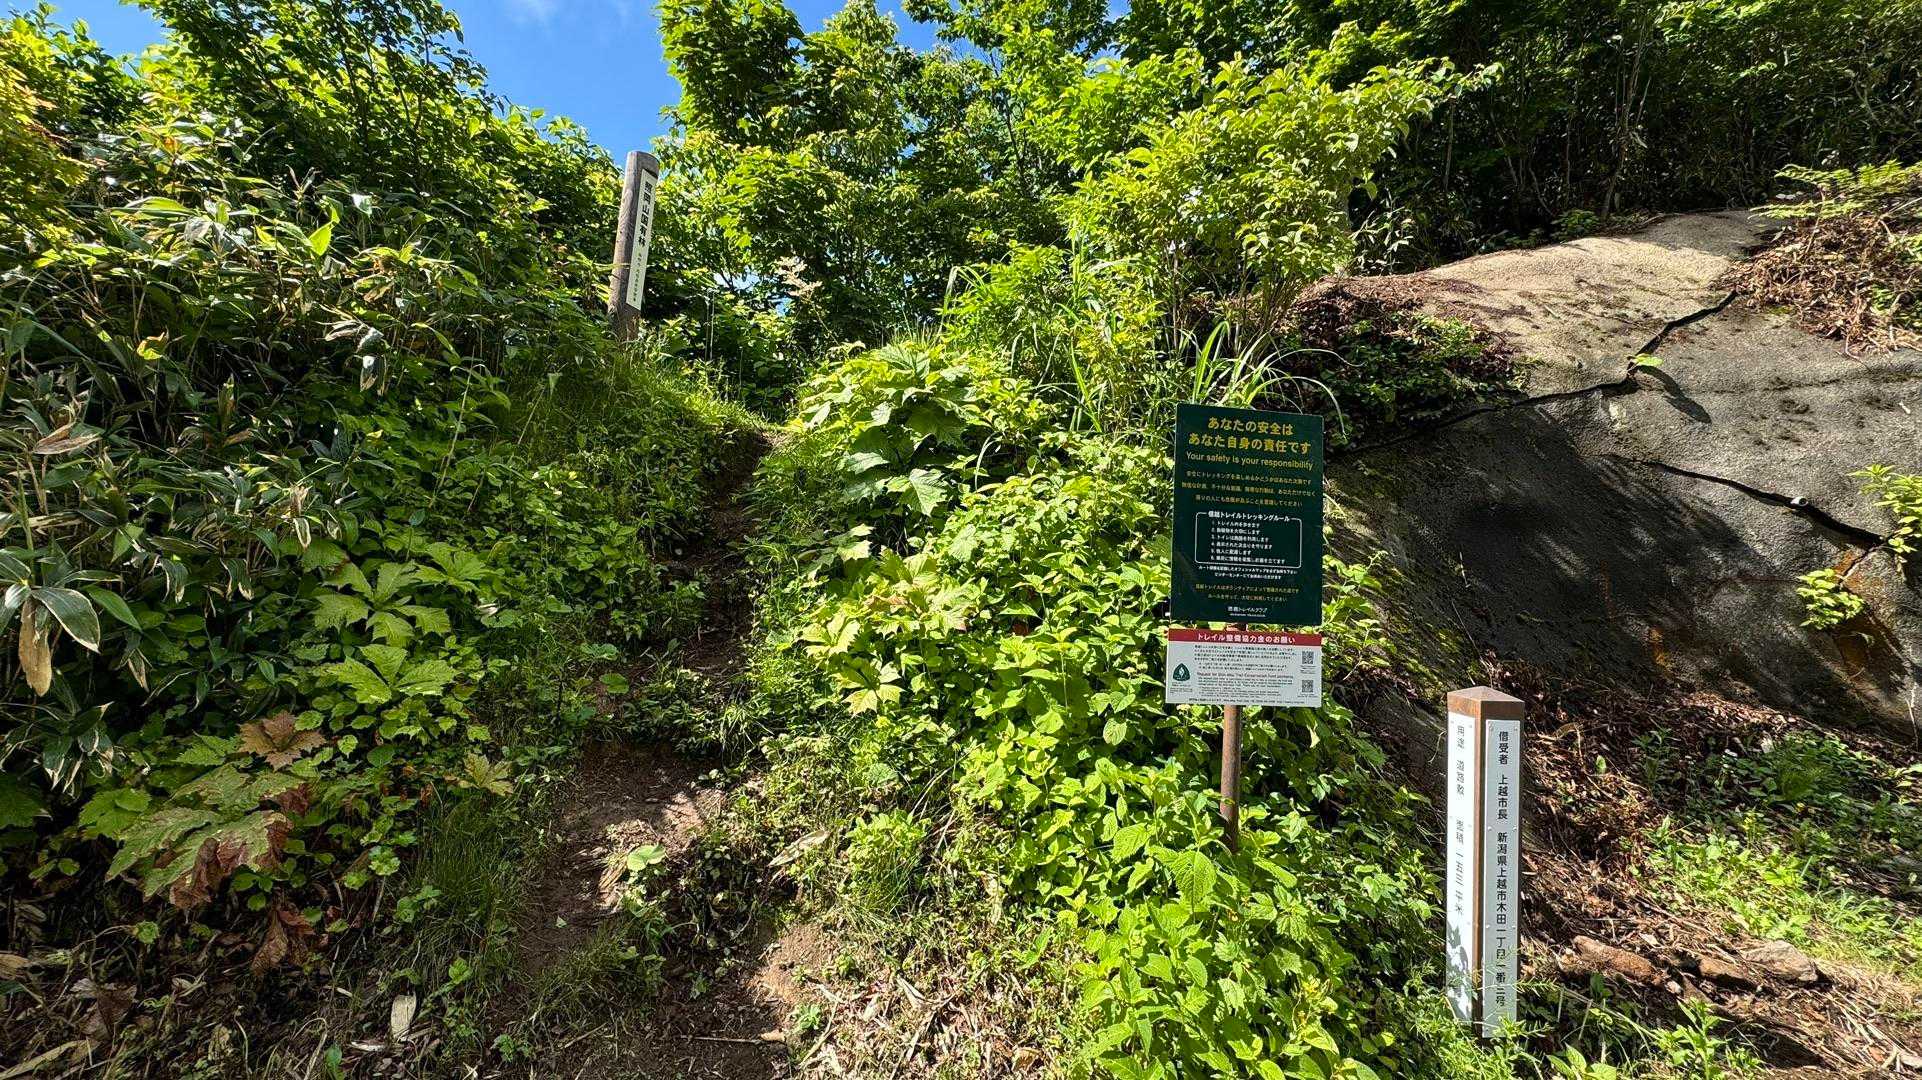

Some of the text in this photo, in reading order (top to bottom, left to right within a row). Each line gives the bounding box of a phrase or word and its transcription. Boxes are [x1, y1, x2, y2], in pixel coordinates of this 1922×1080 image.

[1208, 417, 1293, 435] あなたの安全は
[1188, 433, 1311, 454] あなた自身の責任です
[1186, 451, 1204, 460] Your
[1206, 454, 1231, 463] safety
[1241, 457, 1259, 466] your
[1261, 459, 1313, 470] responsibility
[1208, 510, 1290, 522] 信越トレイルトレッキングルール
[1197, 633, 1296, 644] トレイル整備協力金のお願い
[1498, 731, 1509, 765] 借受者
[1497, 774, 1508, 820] 上越市長
